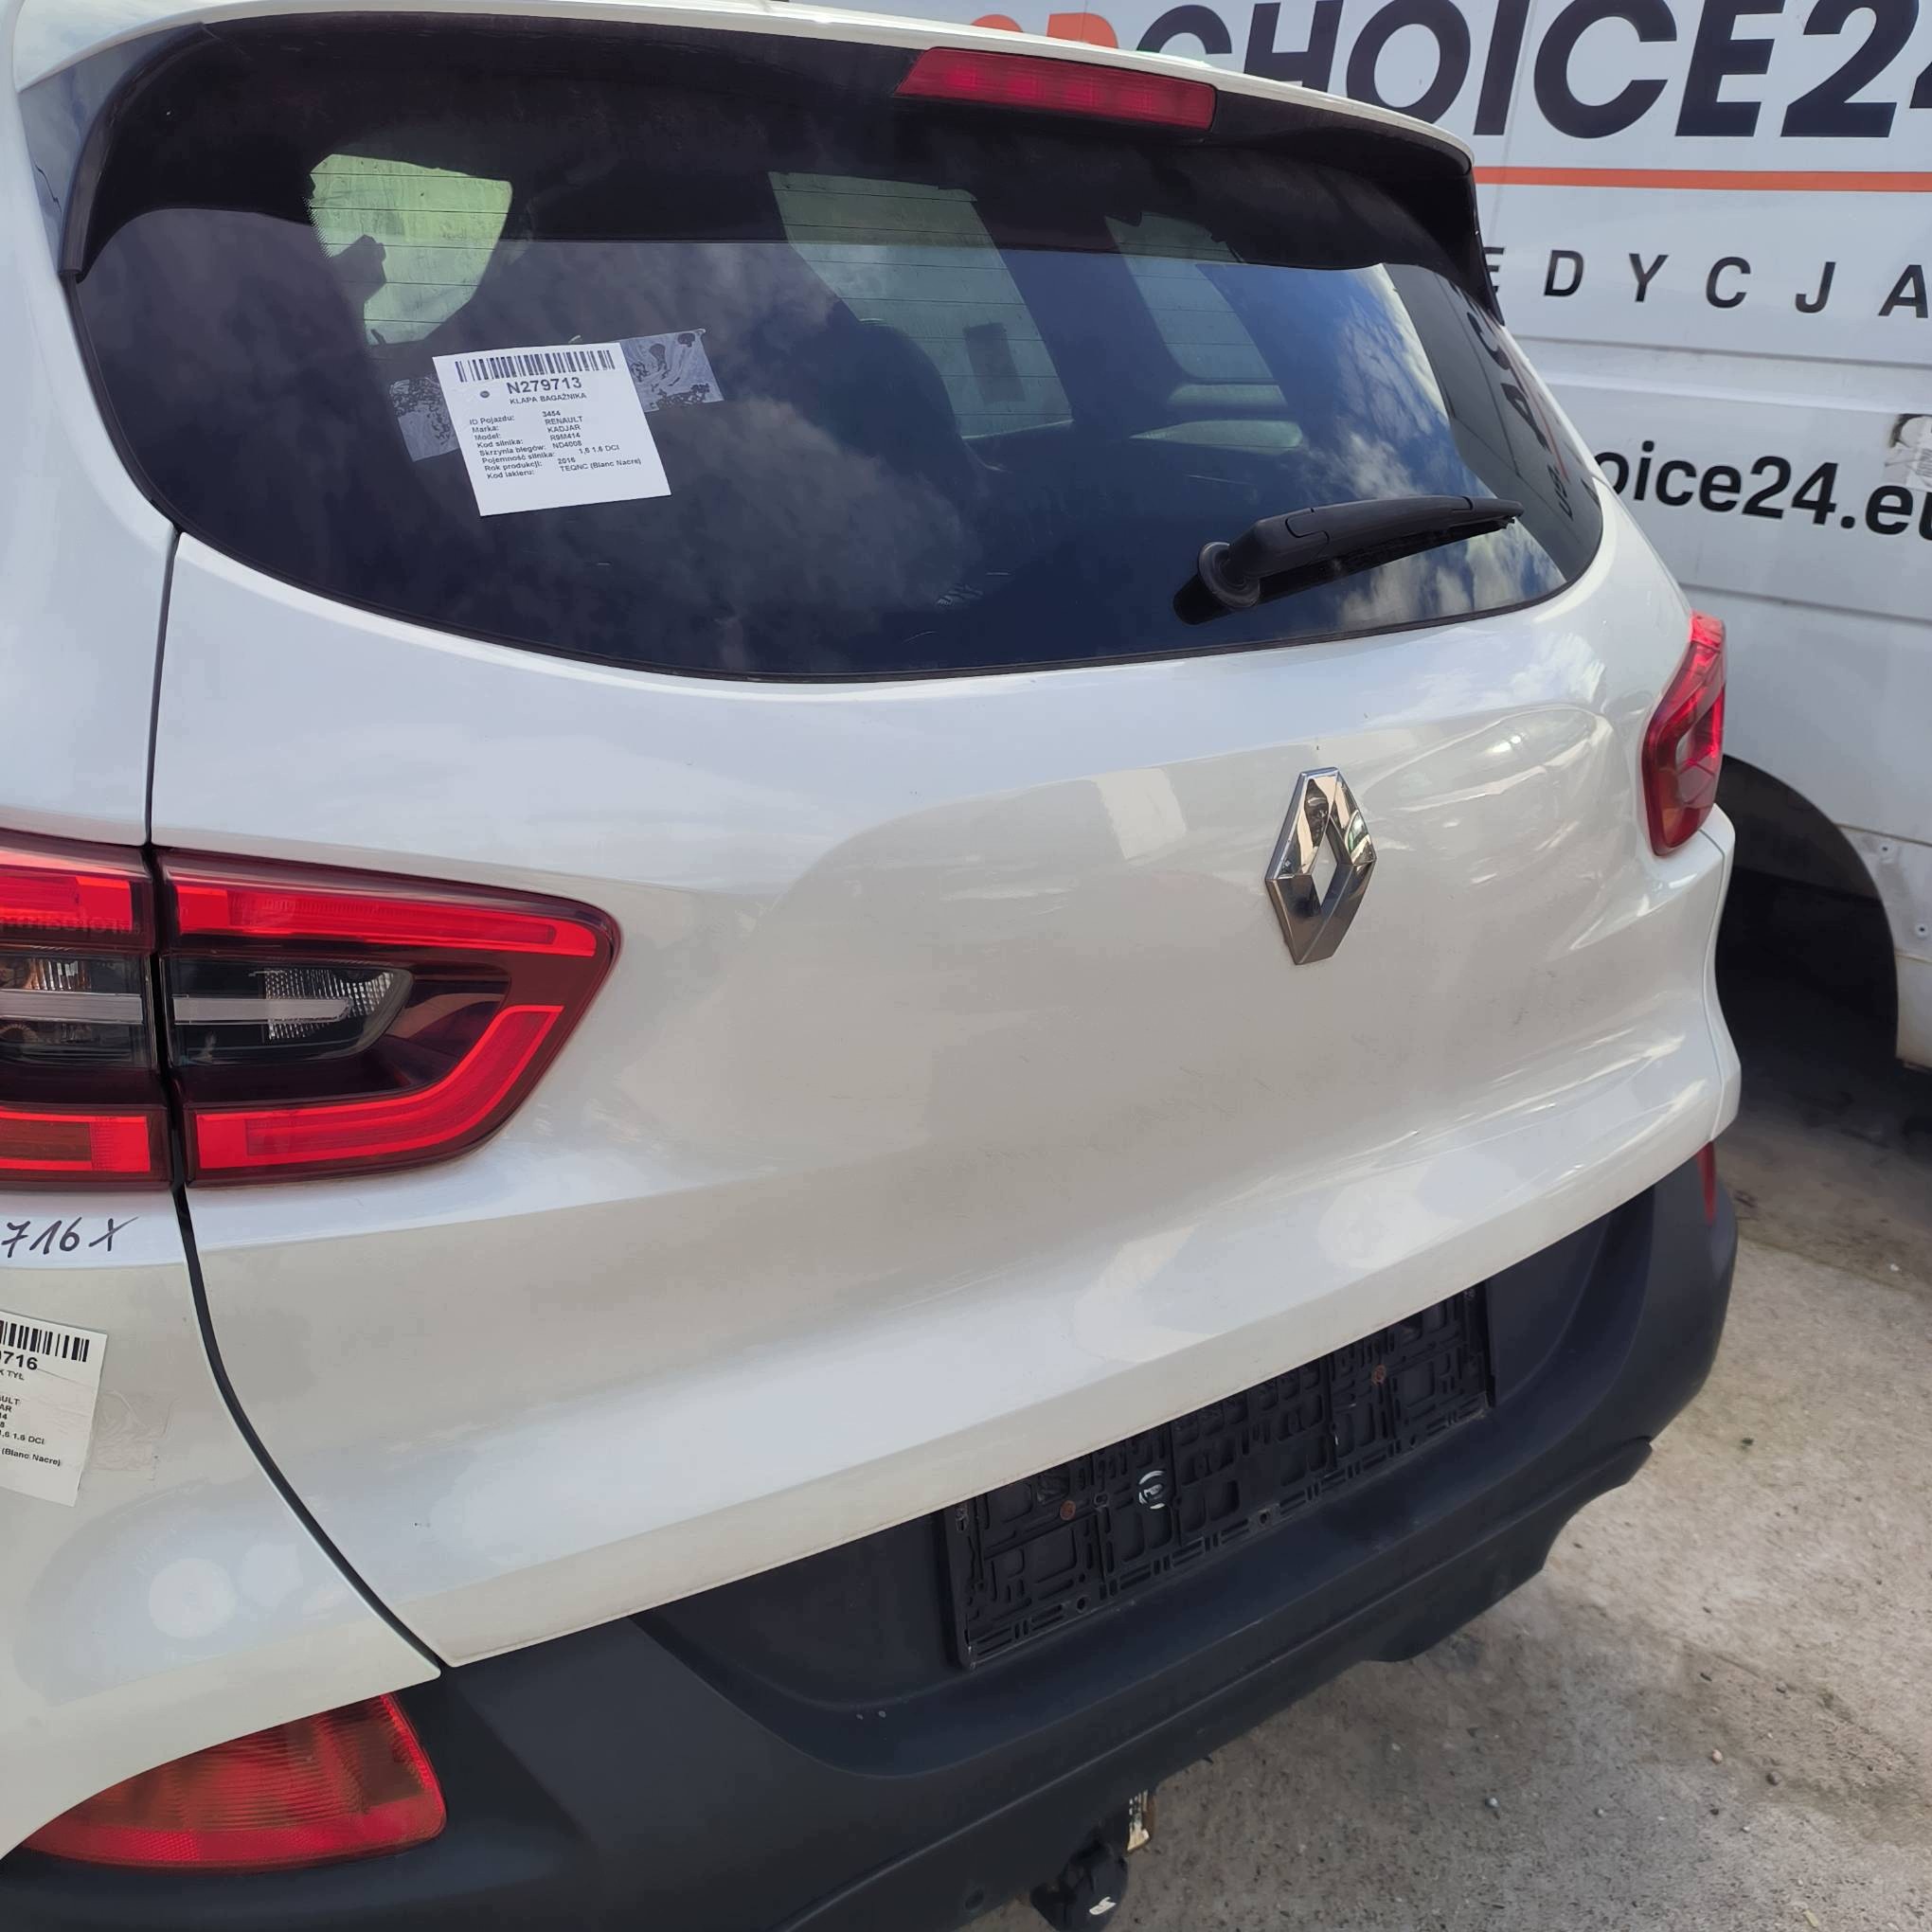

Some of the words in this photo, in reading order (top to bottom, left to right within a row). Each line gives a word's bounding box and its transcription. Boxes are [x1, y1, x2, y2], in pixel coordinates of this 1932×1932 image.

[506, 377, 582, 394] N279713
[510, 396, 538, 404] KLAPA
[480, 415, 515, 424] Pojazdu:
[545, 416, 583, 425] RENAULT
[546, 423, 581, 433] KADJAR
[495, 438, 524, 447] silnika:
[549, 432, 581, 441] R9M414
[479, 447, 513, 456] Skrzynia
[481, 455, 527, 464] Pojemność
[528, 452, 555, 460] silnika:
[502, 460, 543, 471] produkcji:
[557, 456, 576, 465] 2016
[590, 460, 615, 470] (Blanc
[616, 457, 642, 466] Nacre)
[0, 1351, 38, 1370] 716
[0, 1395, 20, 1405] ULT
[2, 1448, 29, 1459] (Blanc
[32, 1454, 61, 1466] Nacre)
